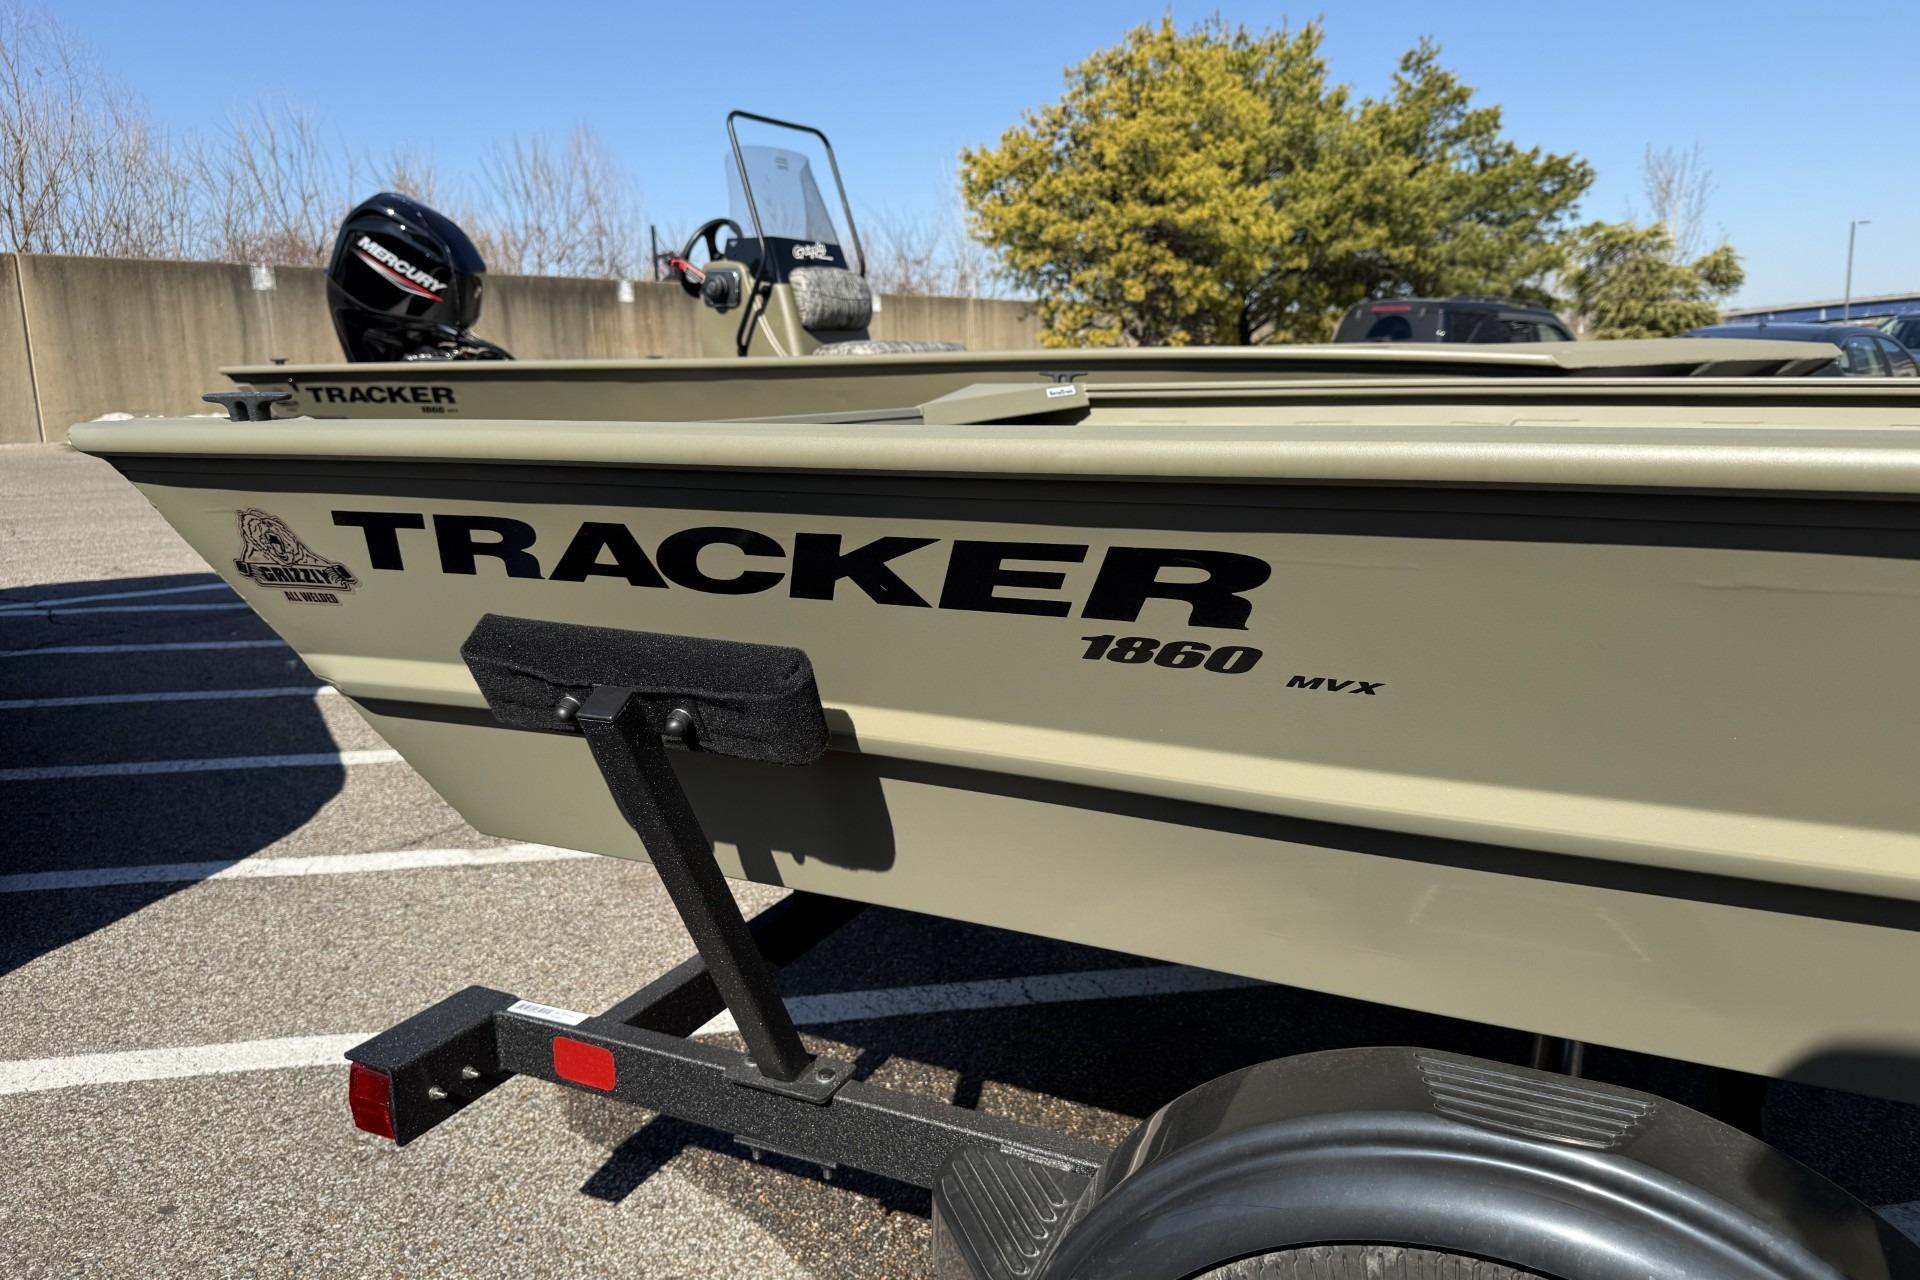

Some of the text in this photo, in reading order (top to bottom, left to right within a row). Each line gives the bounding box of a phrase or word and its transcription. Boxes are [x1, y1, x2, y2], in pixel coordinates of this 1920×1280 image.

[357, 236, 448, 292] MERCURY
[306, 386, 456, 404] TRACKER
[260, 566, 334, 584] GRIZZLY
[330, 510, 1272, 631] TRACKER
[285, 591, 339, 604] ALL WELDED
[1081, 635, 1264, 674] 1860
[1285, 676, 1386, 696] MVX
